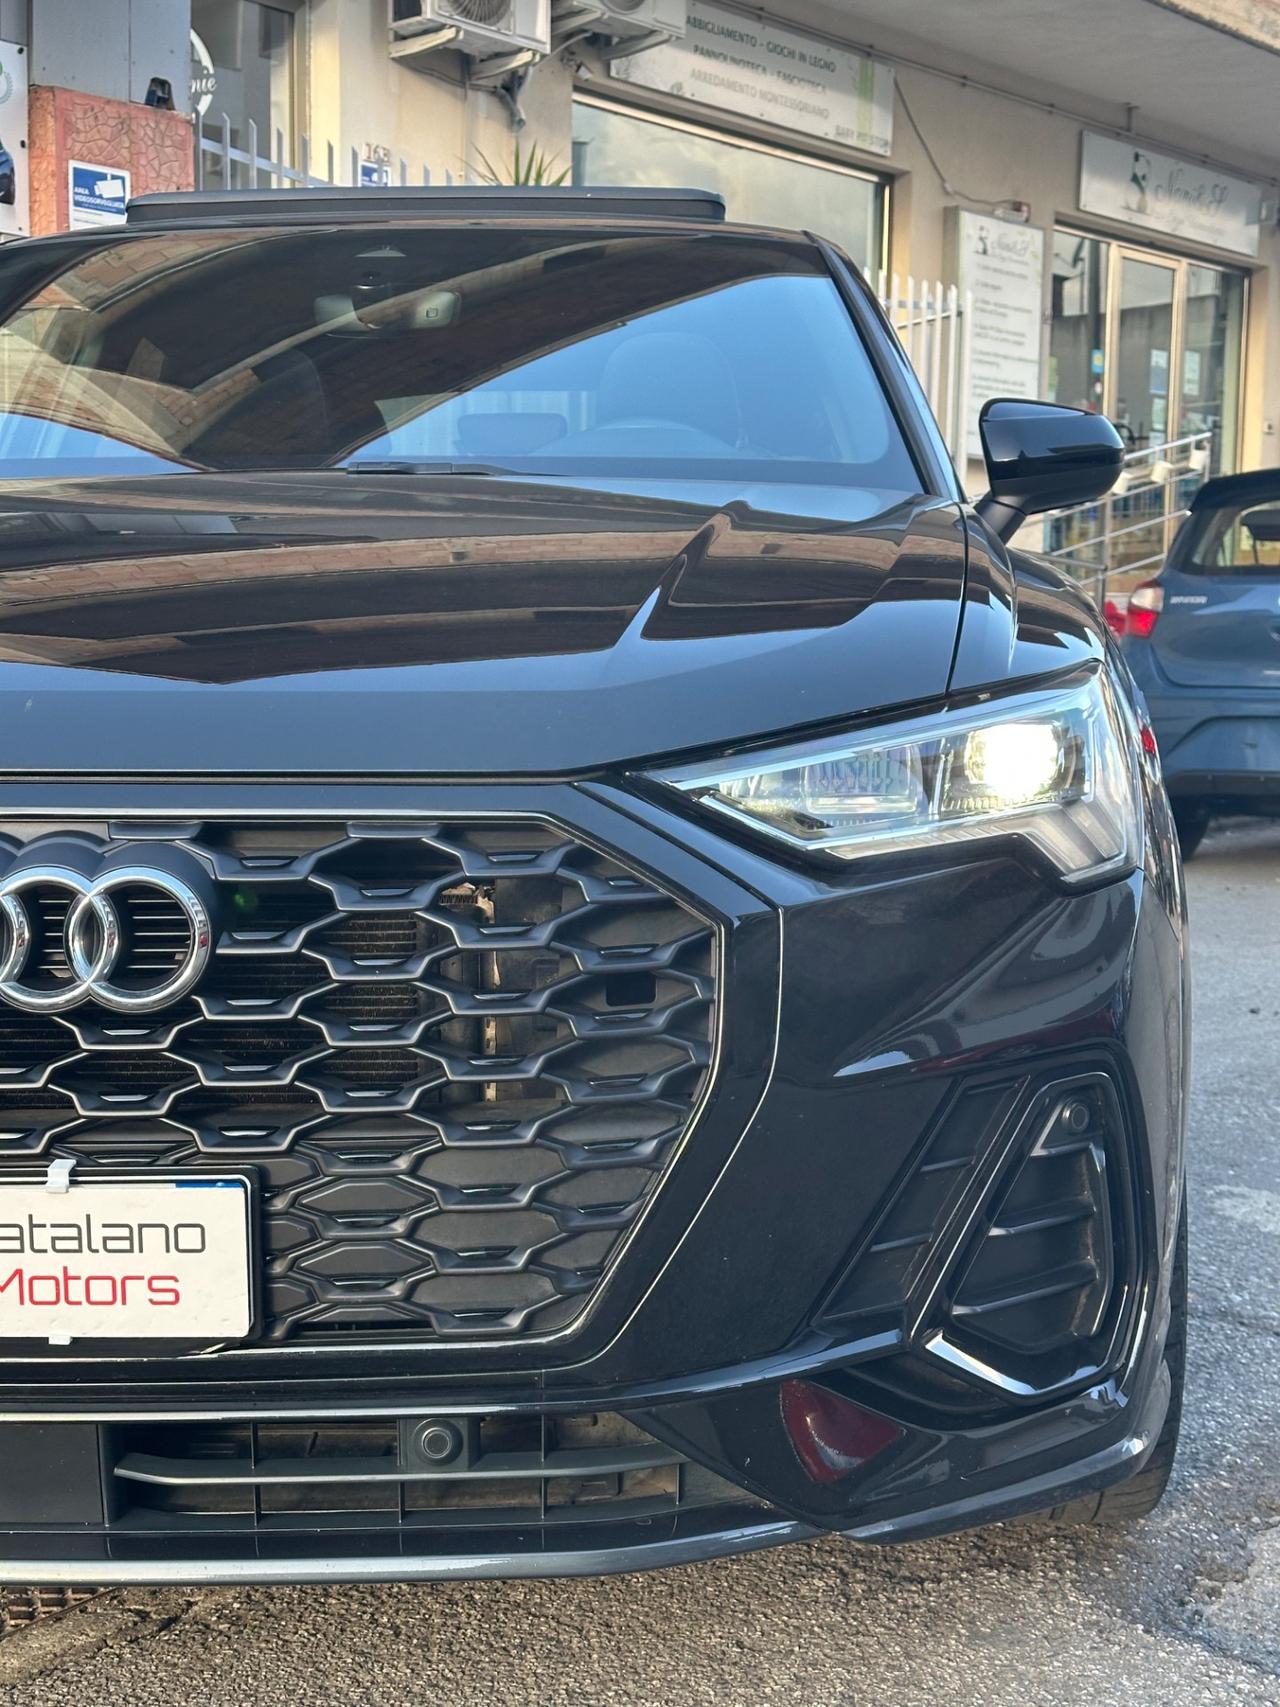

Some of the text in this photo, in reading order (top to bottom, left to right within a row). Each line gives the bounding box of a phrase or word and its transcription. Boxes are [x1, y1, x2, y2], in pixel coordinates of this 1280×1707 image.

[686, 15, 757, 48] ABBIGLIAMENTO
[766, 41, 797, 62] GIOCHI
[798, 51, 808, 65] IN
[808, 54, 837, 73] LEGNO
[690, 68, 757, 99] ARREDAMENTO
[74, 186, 90, 196] AREA
